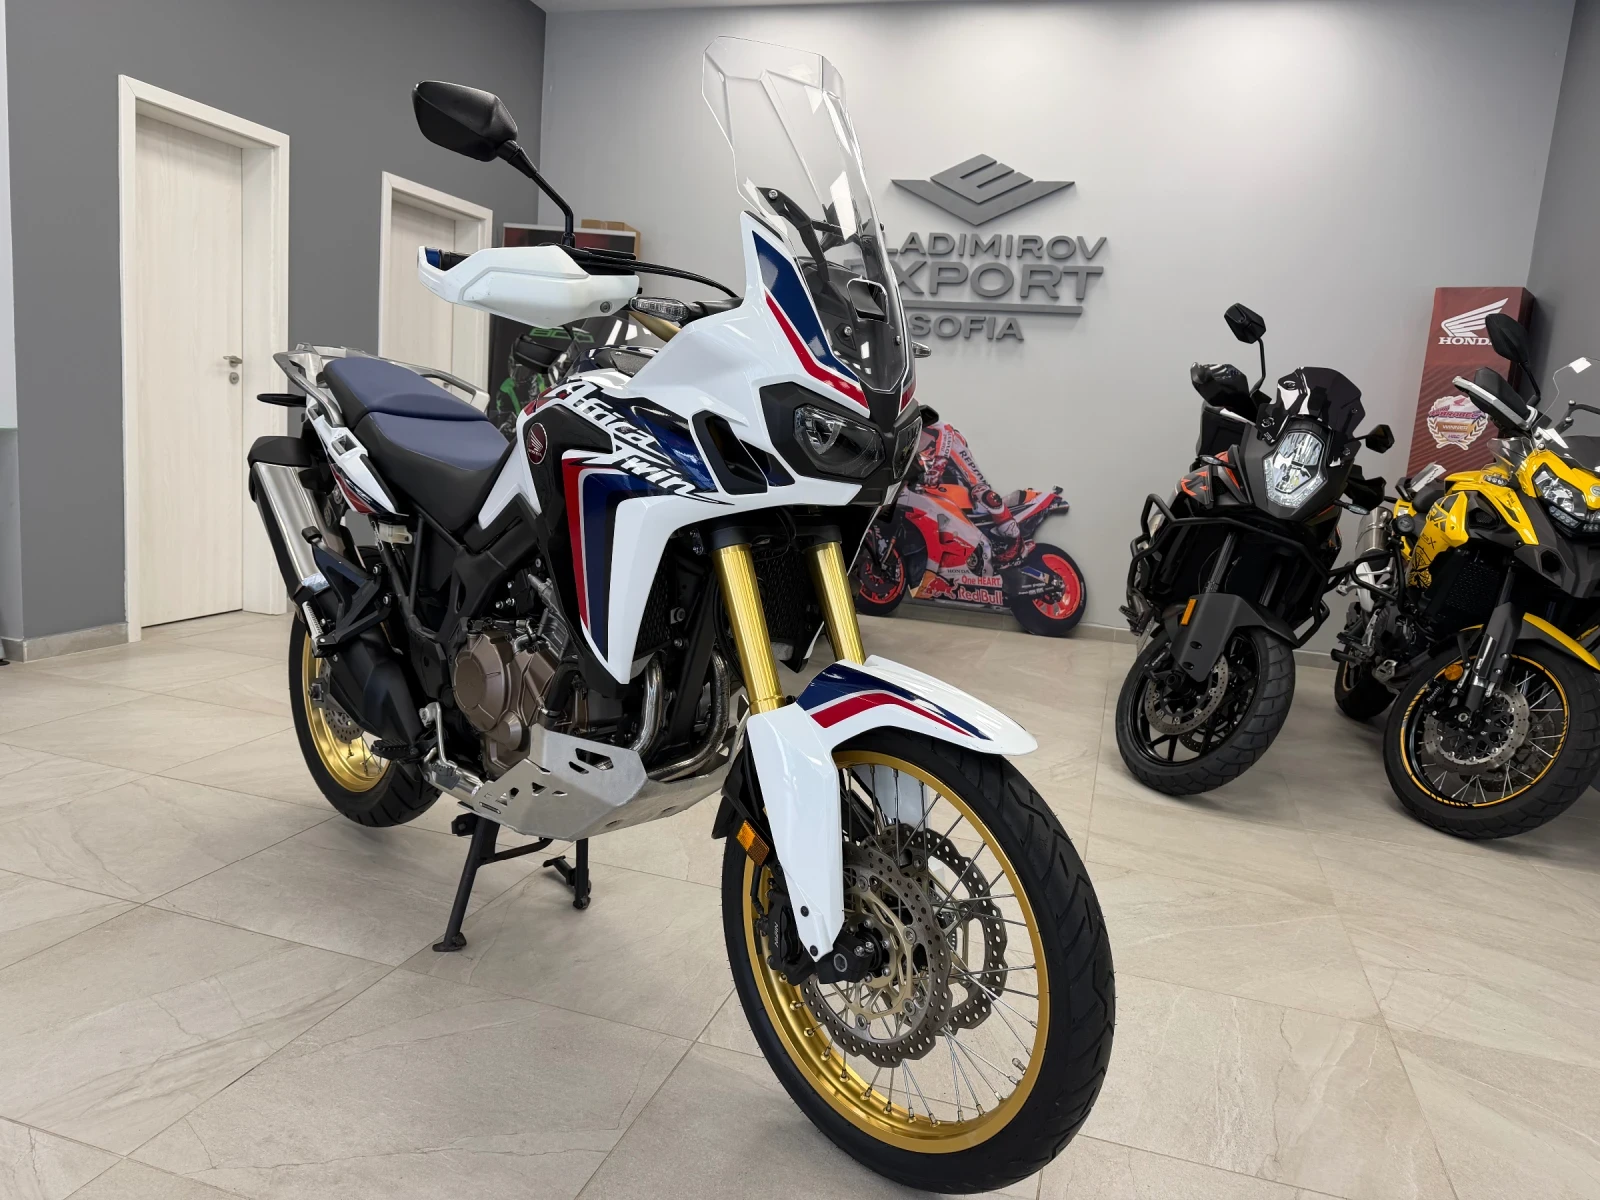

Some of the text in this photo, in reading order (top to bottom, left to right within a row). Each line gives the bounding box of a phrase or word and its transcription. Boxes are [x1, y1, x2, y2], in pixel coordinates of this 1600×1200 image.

[909, 313, 1024, 341] SOFIA
[1438, 336, 1493, 346] HOND
[541, 379, 668, 458] Africa
[583, 436, 712, 503] Twin
[961, 575, 977, 585] One
[958, 586, 1003, 606] Red Bull
